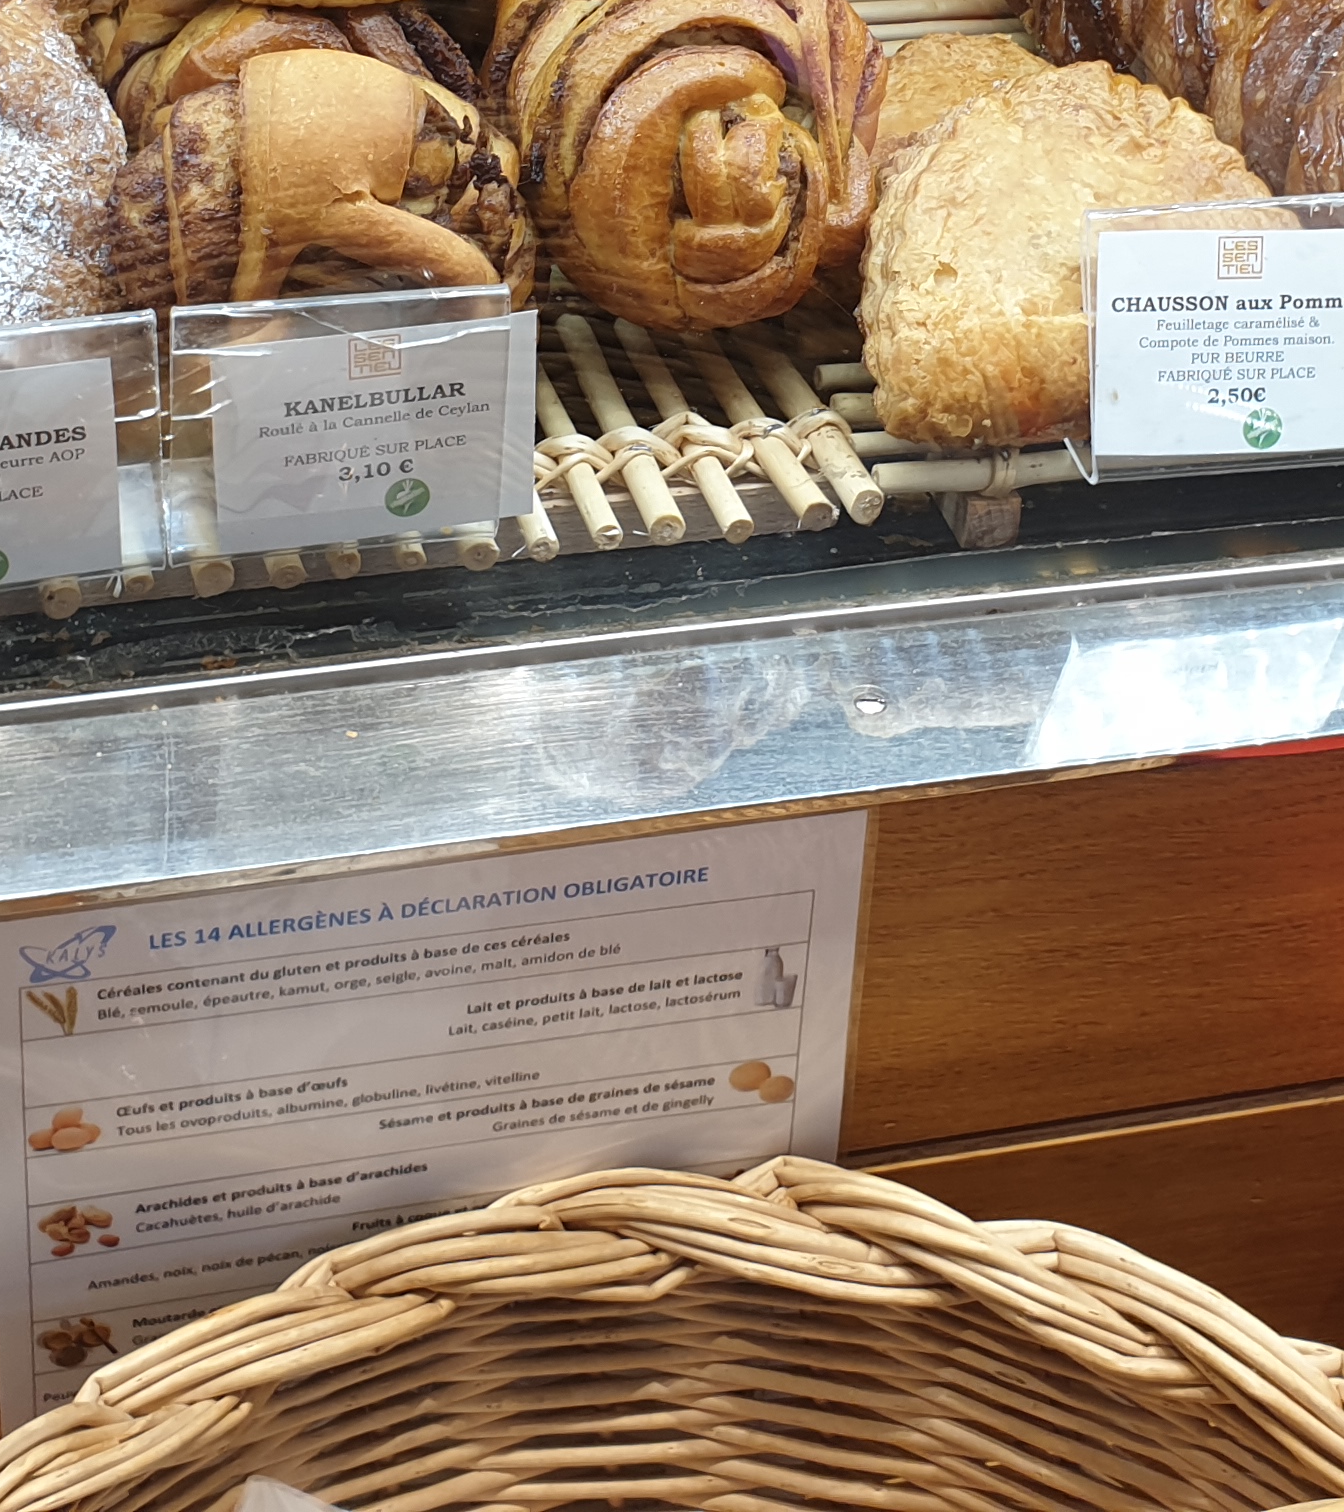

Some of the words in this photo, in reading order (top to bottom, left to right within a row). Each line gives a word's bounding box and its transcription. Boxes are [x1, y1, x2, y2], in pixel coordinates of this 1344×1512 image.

[1111, 295, 1229, 313] CHAUSSON
[1235, 298, 1273, 311] aux
[1156, 318, 1230, 333] Feuilletage
[1233, 316, 1305, 330] caramélisé
[1308, 315, 1320, 328] &
[283, 382, 466, 418] KANELBULLAR
[1207, 386, 1266, 407] 2,50€
[398, 458, 414, 474] €
[149, 930, 187, 950] LES
[194, 926, 221, 945] 14
[227, 908, 372, 941] ALLERGÈNES
[377, 902, 394, 922] À
[401, 884, 557, 919] DÉCLARATION
[563, 866, 710, 899] OBLIGATOIRE
[466, 1001, 493, 1015] Lait
[496, 999, 511, 1011] et
[515, 992, 576, 1011] produits
[578, 988, 588, 1000] à
[591, 986, 625, 999] base
[627, 982, 646, 994] de
[648, 978, 672, 992] lait
[675, 976, 690, 988] et
[693, 971, 743, 986] lactose
[157, 1100, 175, 1112] et
[178, 1092, 242, 1112] produits
[245, 1089, 255, 1101] à
[258, 1086, 294, 1099] base
